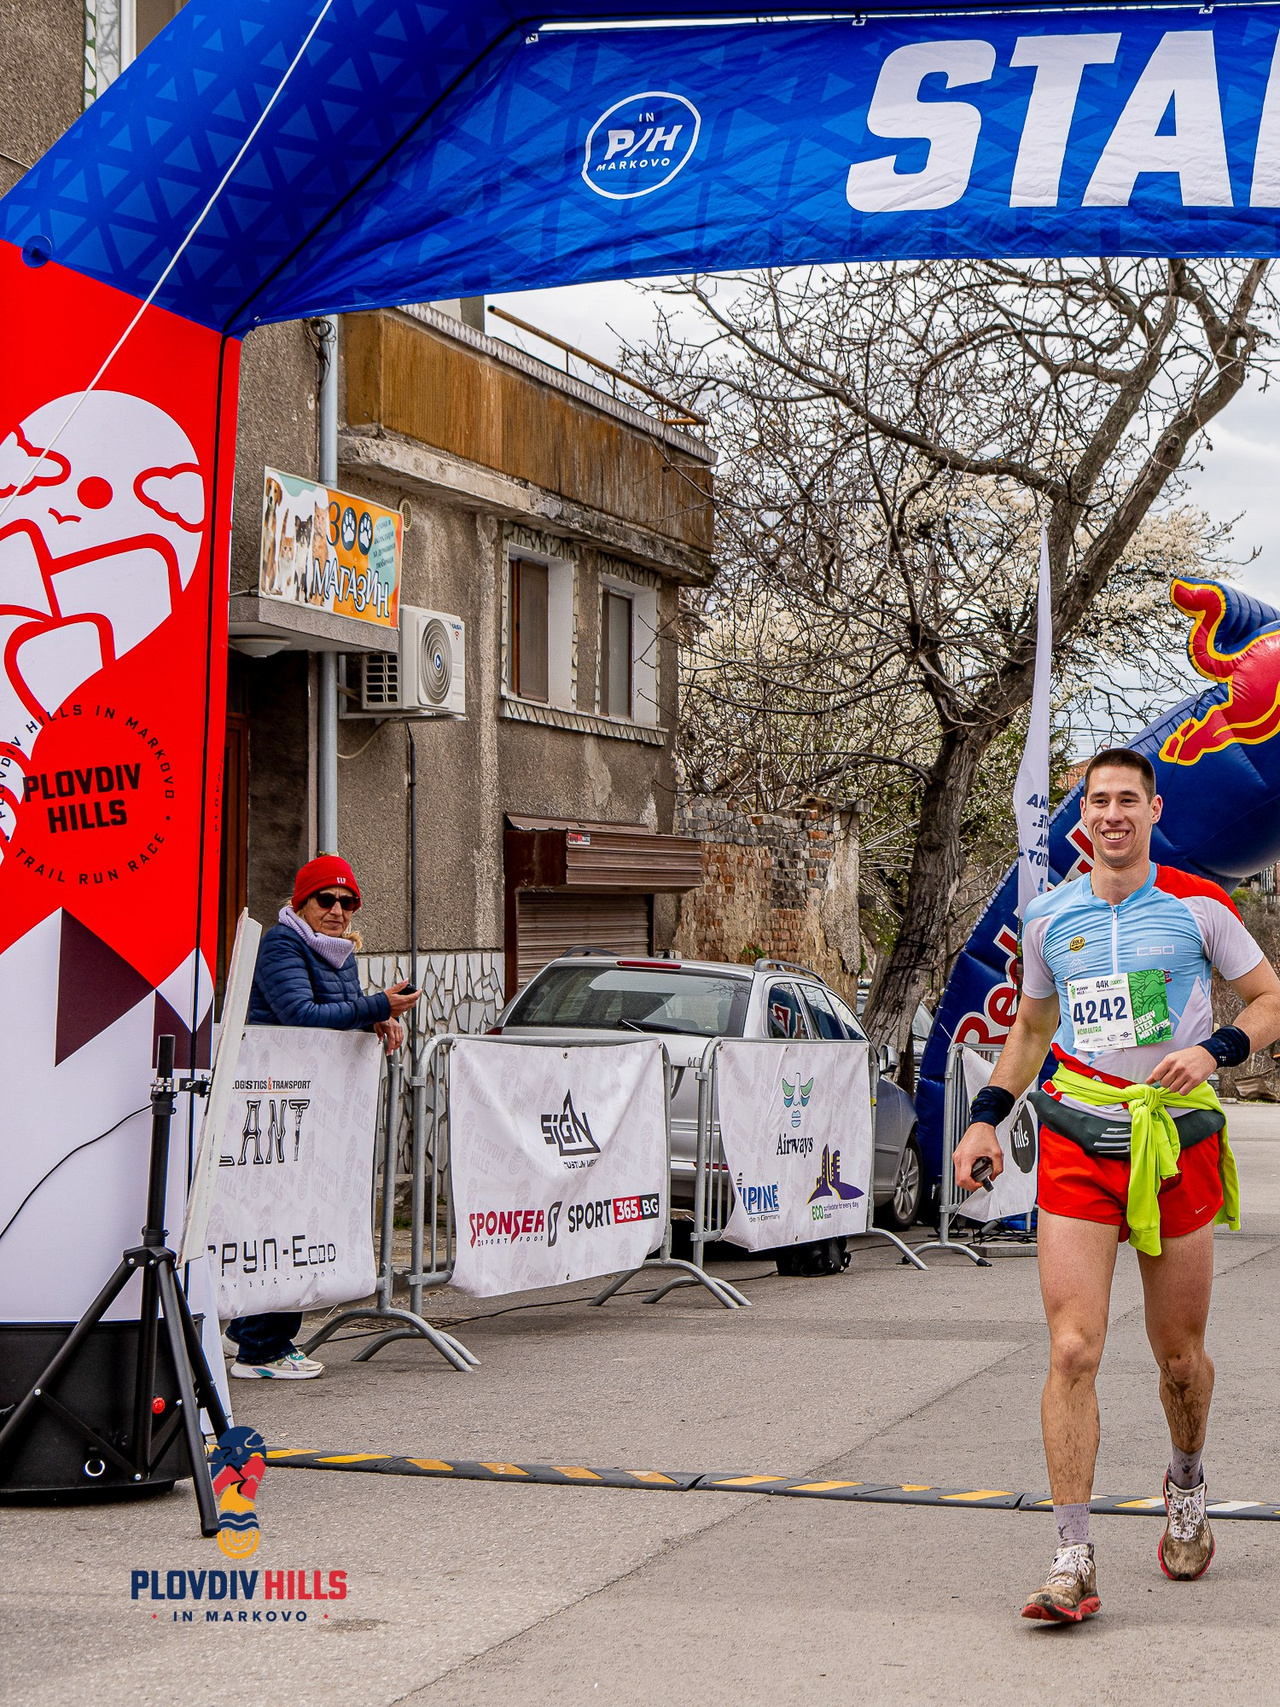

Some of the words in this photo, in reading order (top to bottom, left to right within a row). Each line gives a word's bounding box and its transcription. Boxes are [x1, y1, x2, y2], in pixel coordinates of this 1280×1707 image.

[638, 112, 655, 122] IN
[603, 124, 683, 161] P/H
[595, 157, 671, 172] MARKOVO
[312, 557, 390, 618] МАГАЗИН
[25, 704, 83, 734] HILLS
[95, 705, 117, 720] IN
[125, 716, 175, 799] MARKOVO
[22, 763, 142, 803] PLOVDIV
[47, 799, 128, 834] HILLS
[16, 847, 66, 883] TRAIL
[78, 868, 119, 885] RUN
[127, 832, 166, 873] RACE
[1073, 996, 1128, 1026] 4242
[231, 1080, 268, 1090] OGISTICS
[272, 1080, 312, 1090] TRANSPORT
[218, 1099, 311, 1167] ANT
[776, 1133, 814, 1159] Airways
[469, 1209, 545, 1248] SPONSER
[811, 1205, 824, 1221] ECO
